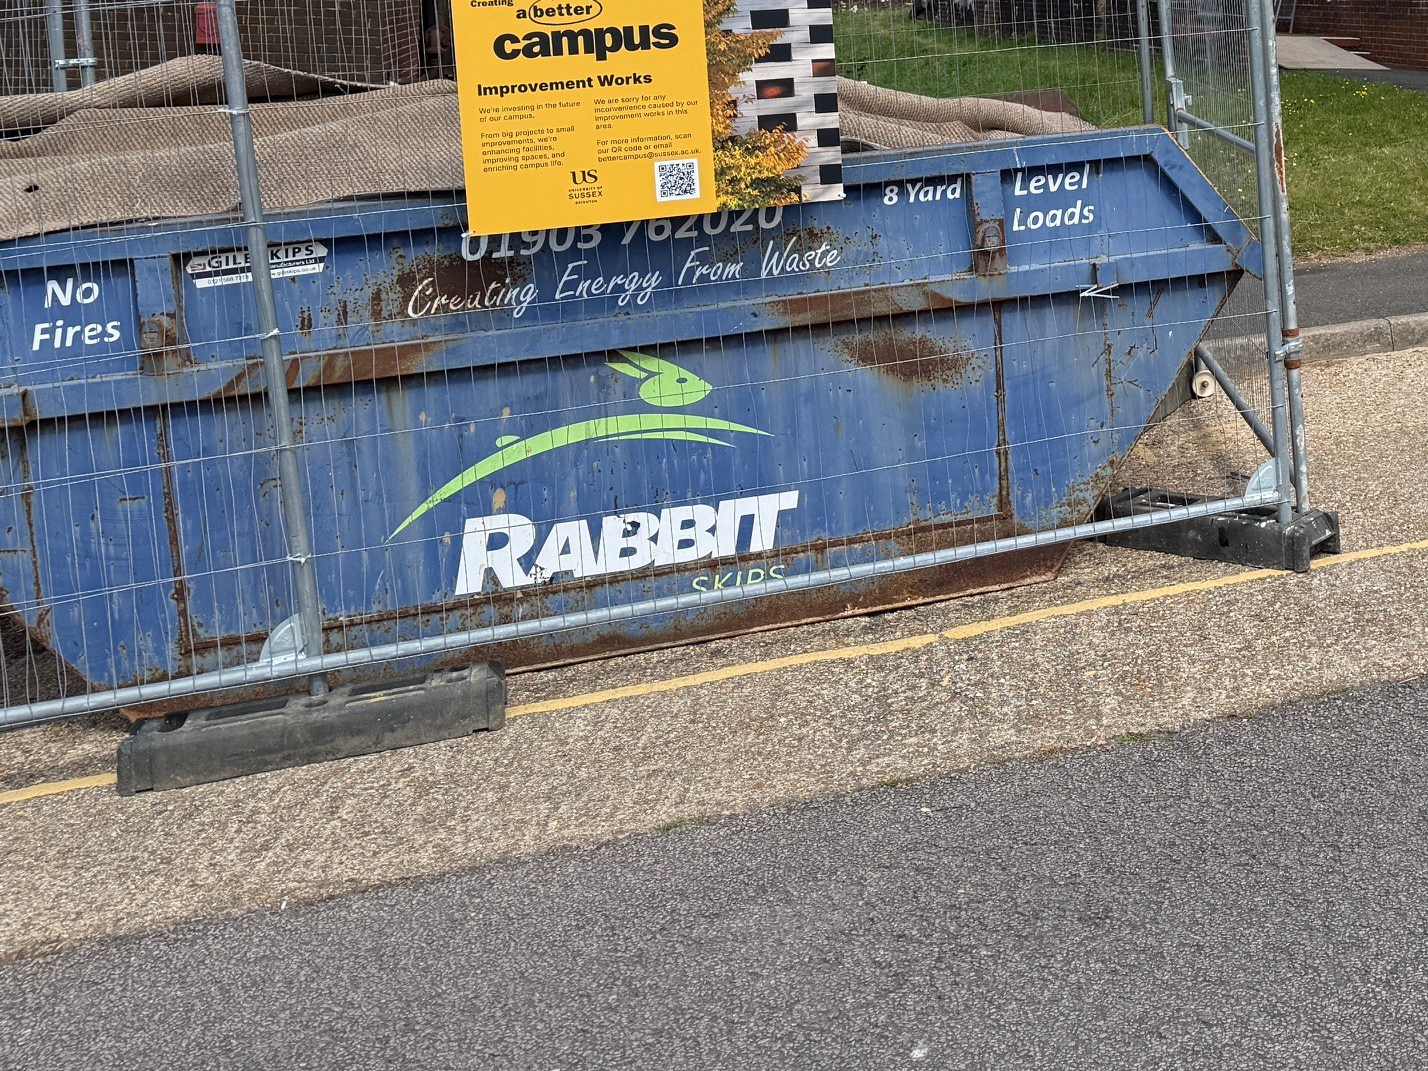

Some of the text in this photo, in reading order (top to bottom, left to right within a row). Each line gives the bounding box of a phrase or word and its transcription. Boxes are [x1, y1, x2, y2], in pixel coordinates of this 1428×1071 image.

[516, 3, 593, 19] a better
[493, 23, 679, 62] campus
[477, 72, 653, 98] Improvement Works
[502, 104, 535, 113] investing
[594, 104, 646, 113] inconvenience
[648, 101, 674, 109] caused
[479, 115, 487, 123] of
[503, 113, 535, 122] campus.
[595, 112, 642, 122] improvement
[502, 130, 513, 139] big
[515, 128, 545, 137] projects
[555, 125, 575, 133] small
[631, 135, 673, 143] information,
[481, 138, 536, 148] improvements,
[482, 144, 555, 156] enhancing facilities,
[482, 155, 519, 165] improving
[521, 153, 550, 162] spaces,
[483, 163, 518, 173] enriching
[520, 161, 549, 169] campus
[1014, 163, 1091, 196] Level
[569, 191, 602, 199] SUSSEX
[883, 178, 963, 206] 8 Yard
[1012, 199, 1095, 231] Loads
[407, 237, 842, 320] Creating Energy From Waste
[44, 278, 100, 308] No
[32, 319, 121, 351] Fires
[455, 489, 800, 596] RABBIT
